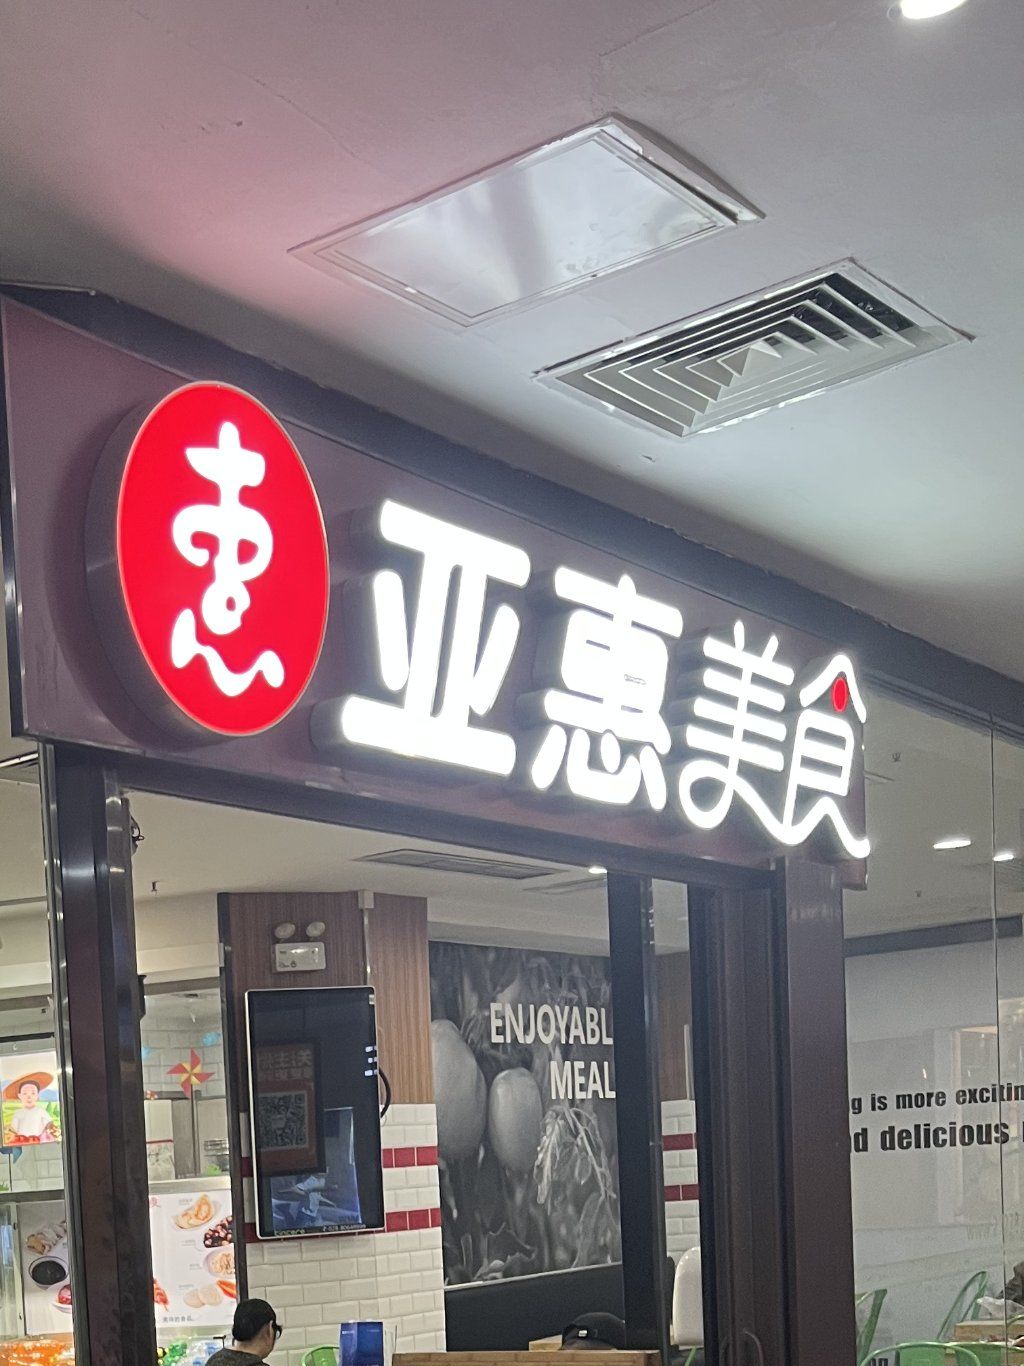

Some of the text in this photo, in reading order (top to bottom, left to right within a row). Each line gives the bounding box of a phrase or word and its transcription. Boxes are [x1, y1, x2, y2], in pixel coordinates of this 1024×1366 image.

[340, 499, 871, 859] 亚惠美食
[550, 1060, 616, 1099] MEAL
[870, 1094, 888, 1112] is
[895, 1091, 947, 1110] more
[880, 1121, 1010, 1151] delicious
